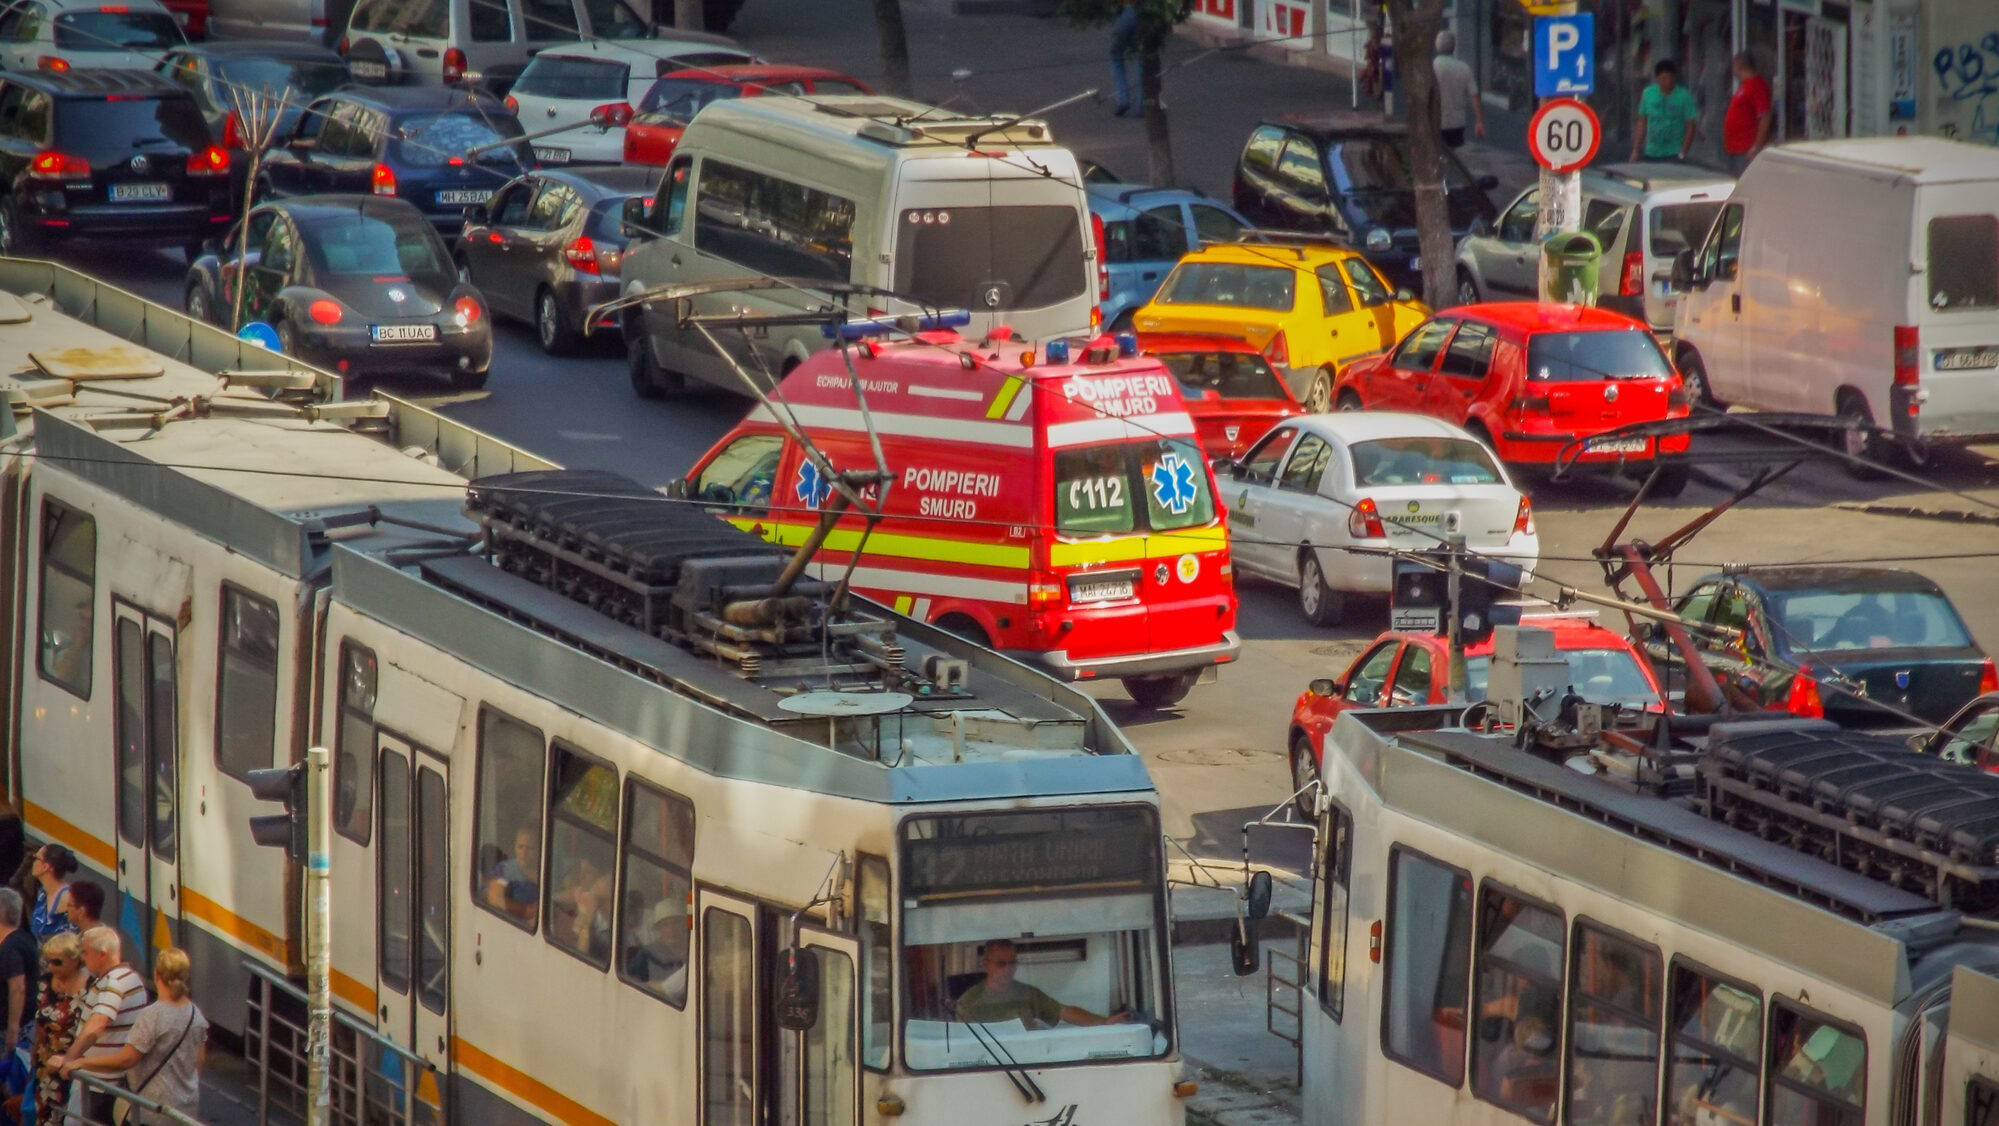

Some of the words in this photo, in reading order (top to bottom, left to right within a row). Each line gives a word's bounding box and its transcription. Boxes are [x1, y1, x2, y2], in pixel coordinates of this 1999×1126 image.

[1549, 23, 1579, 70] P
[1547, 119, 1583, 152] 60
[379, 328, 394, 339] BC
[817, 375, 847, 388] ECHIPAJ
[867, 379, 898, 394] AJUTOR
[1062, 375, 1172, 404] POMPIERII
[1093, 396, 1157, 418] SMURD
[904, 467, 999, 497] POMPIERII
[920, 497, 976, 519] SMURD
